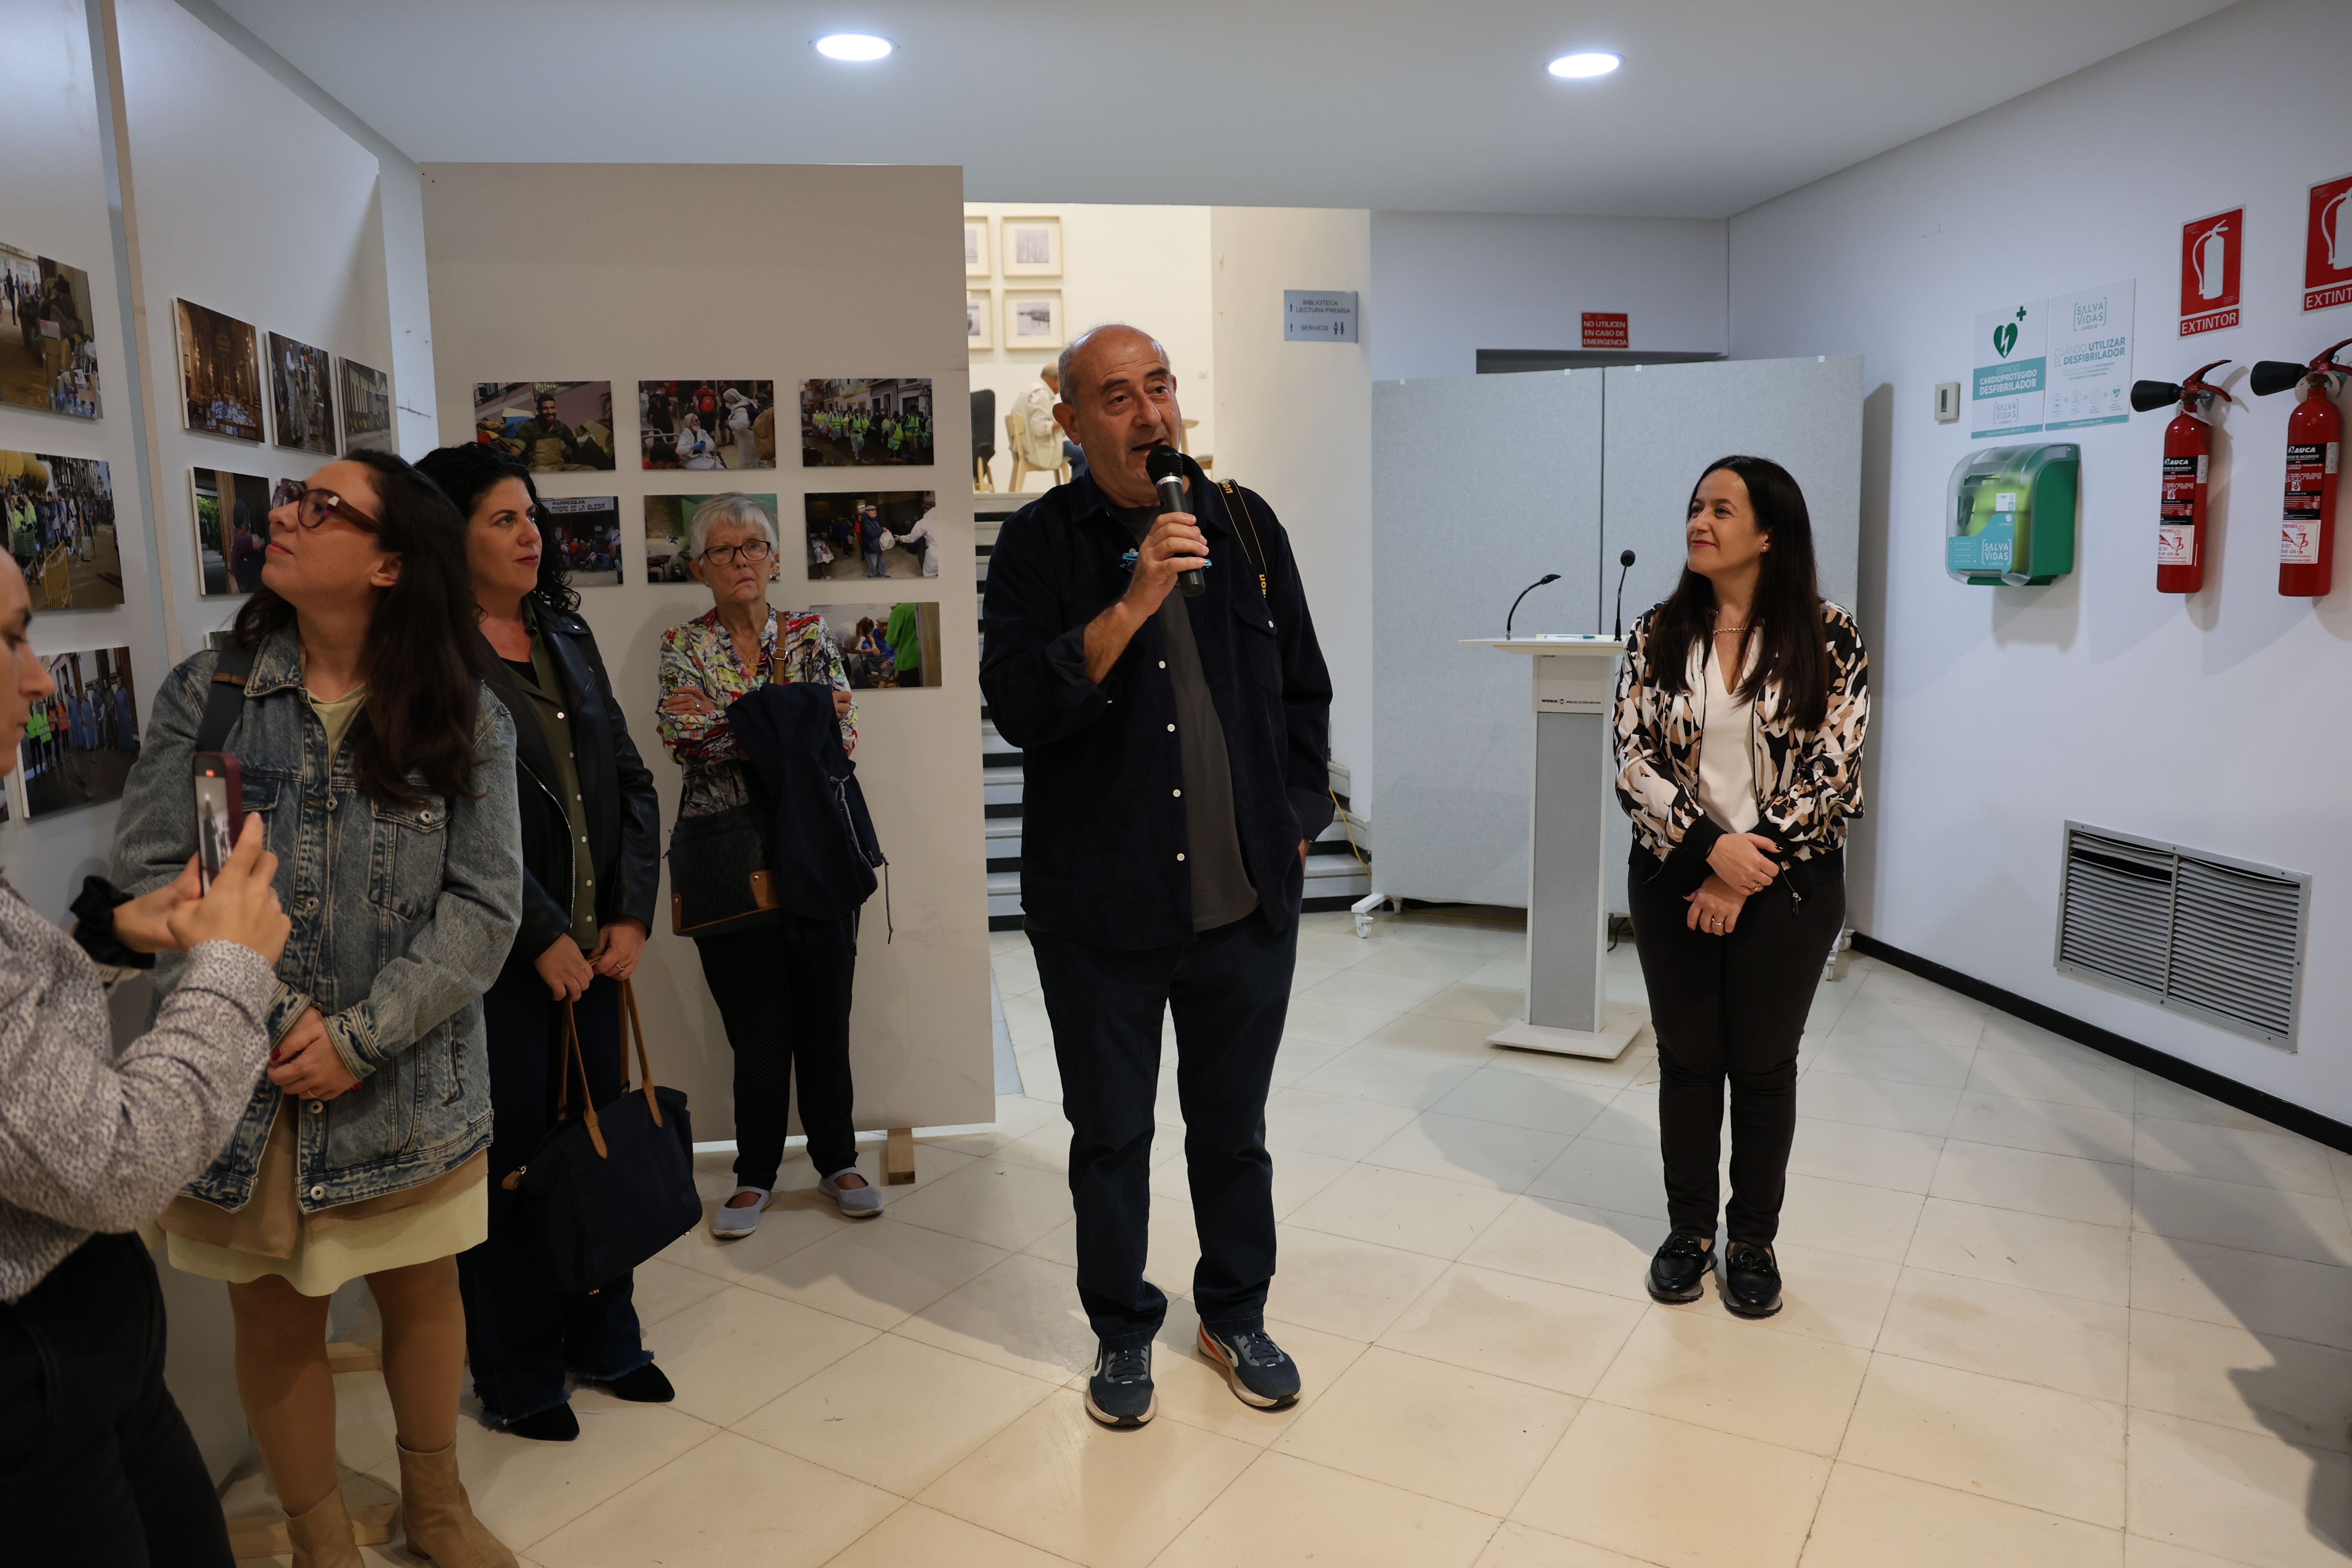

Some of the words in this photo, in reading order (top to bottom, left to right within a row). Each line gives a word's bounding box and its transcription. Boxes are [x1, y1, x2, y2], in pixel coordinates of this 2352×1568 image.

[2306, 287, 2352, 308] EXTINT
[2077, 302, 2103, 315] SALVA
[2077, 312, 2103, 325] VIDAS
[2182, 312, 2236, 334] EXTINTOR
[2089, 337, 2125, 351] UTILIZAR
[2064, 347, 2125, 365] DESFIBRILADOR
[1980, 369, 2037, 385] CARDIOPROTEGIDO
[1980, 378, 2036, 395] DESFIBRILADOR
[1996, 403, 2016, 411] SALVA
[1996, 410, 2016, 420] VIDAS
[1984, 552, 2009, 560] VIDAS
